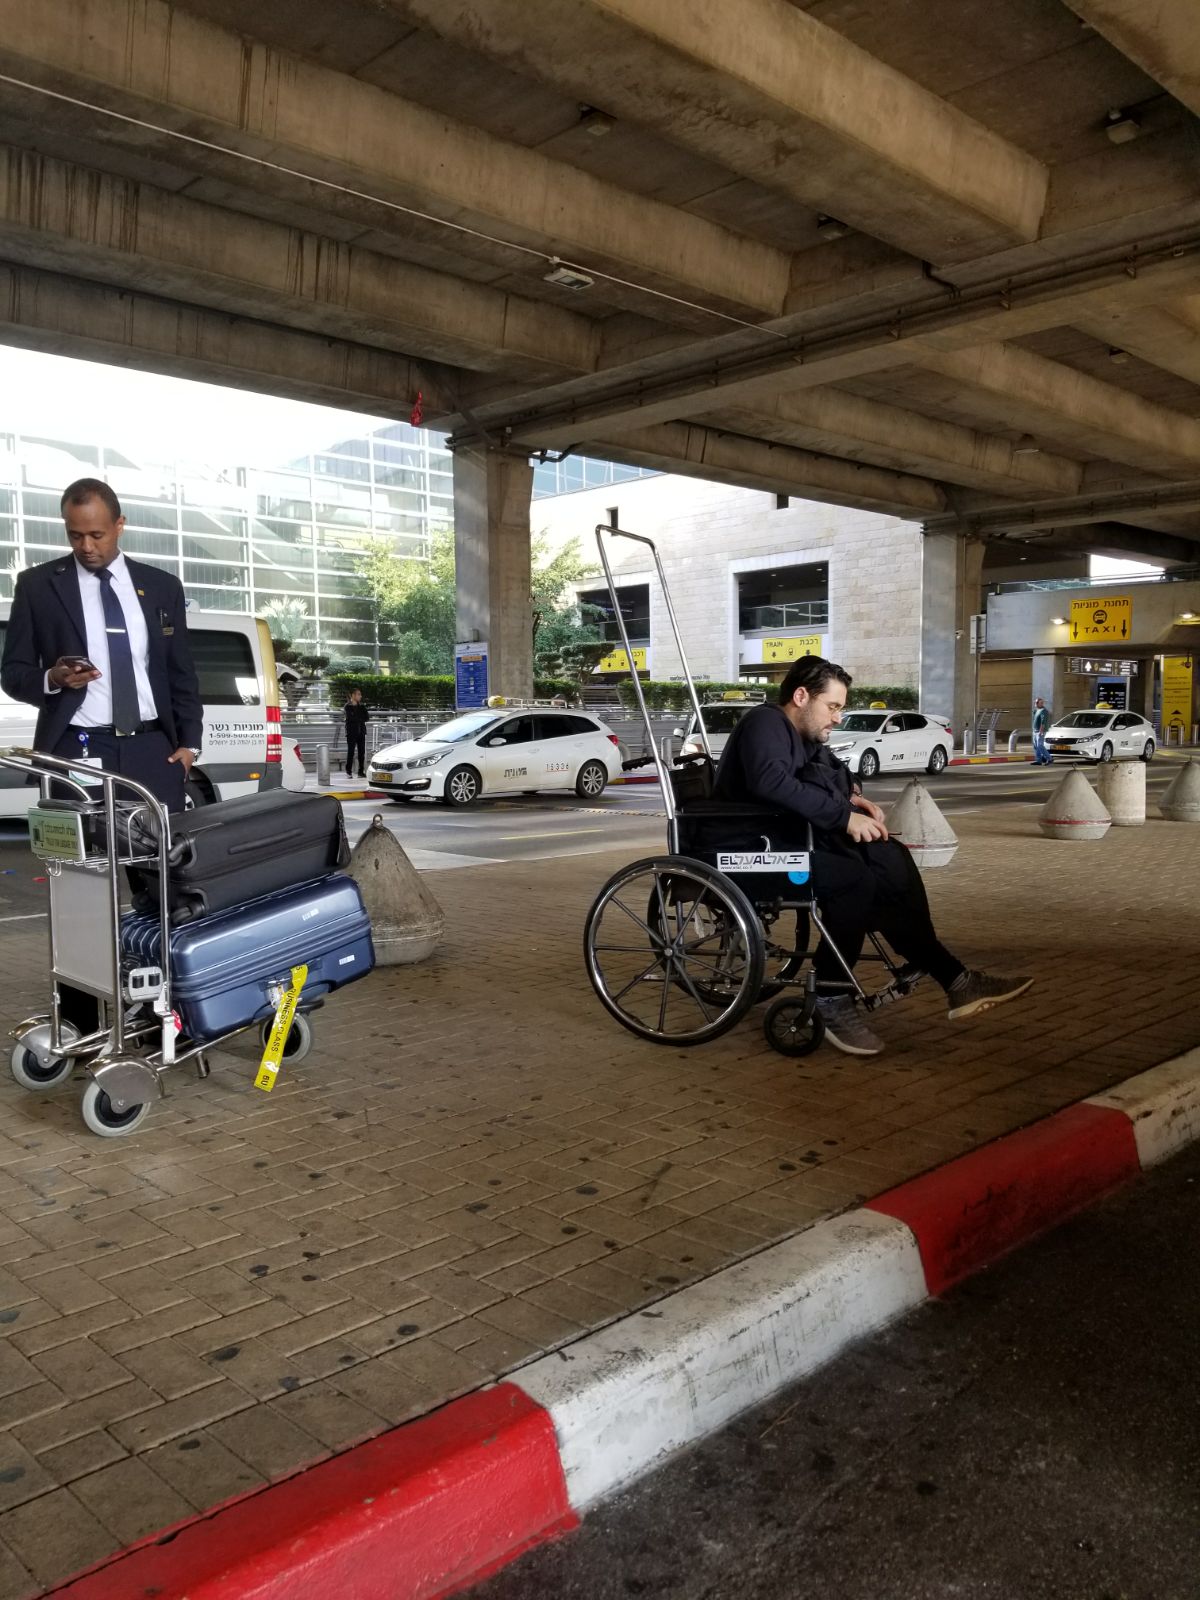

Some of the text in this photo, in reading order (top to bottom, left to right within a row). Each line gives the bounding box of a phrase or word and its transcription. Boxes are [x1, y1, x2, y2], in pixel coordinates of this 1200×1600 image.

[1073, 601, 1099, 609] מוניות
[799, 638, 819, 646] רכבת
[209, 723, 264, 732] מוניות נשר
[272, 1026, 284, 1052] CLASS
